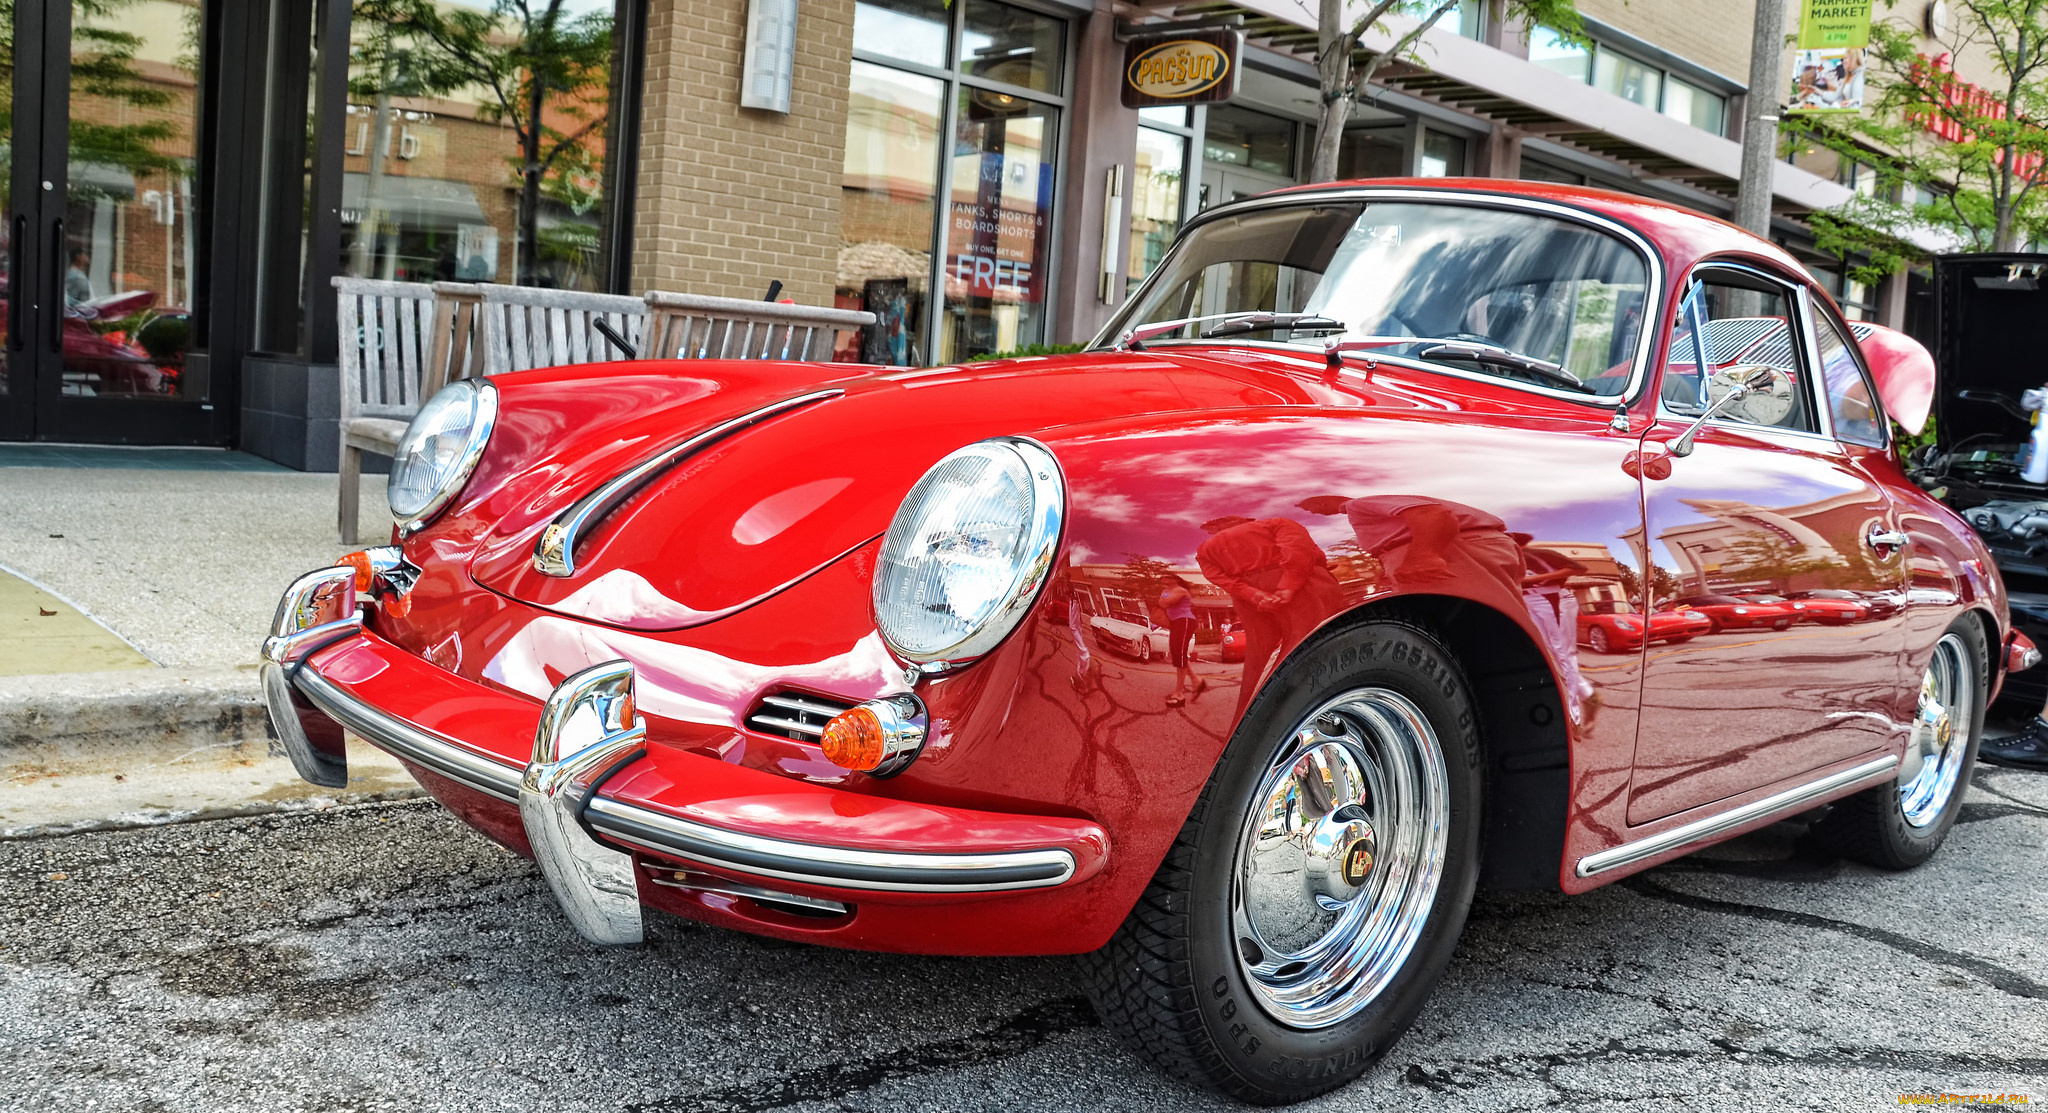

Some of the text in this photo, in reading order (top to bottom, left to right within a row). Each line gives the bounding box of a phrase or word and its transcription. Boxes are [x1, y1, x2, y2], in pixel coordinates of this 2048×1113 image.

[1811, 6, 1867, 19] MARKET
[951, 203, 1043, 226] TANKS, SHORTS &
[956, 218, 1036, 239] BOARDSHORTS
[965, 243, 978, 251] BUY
[997, 247, 1009, 255] GET
[956, 254, 1032, 295] FREE
